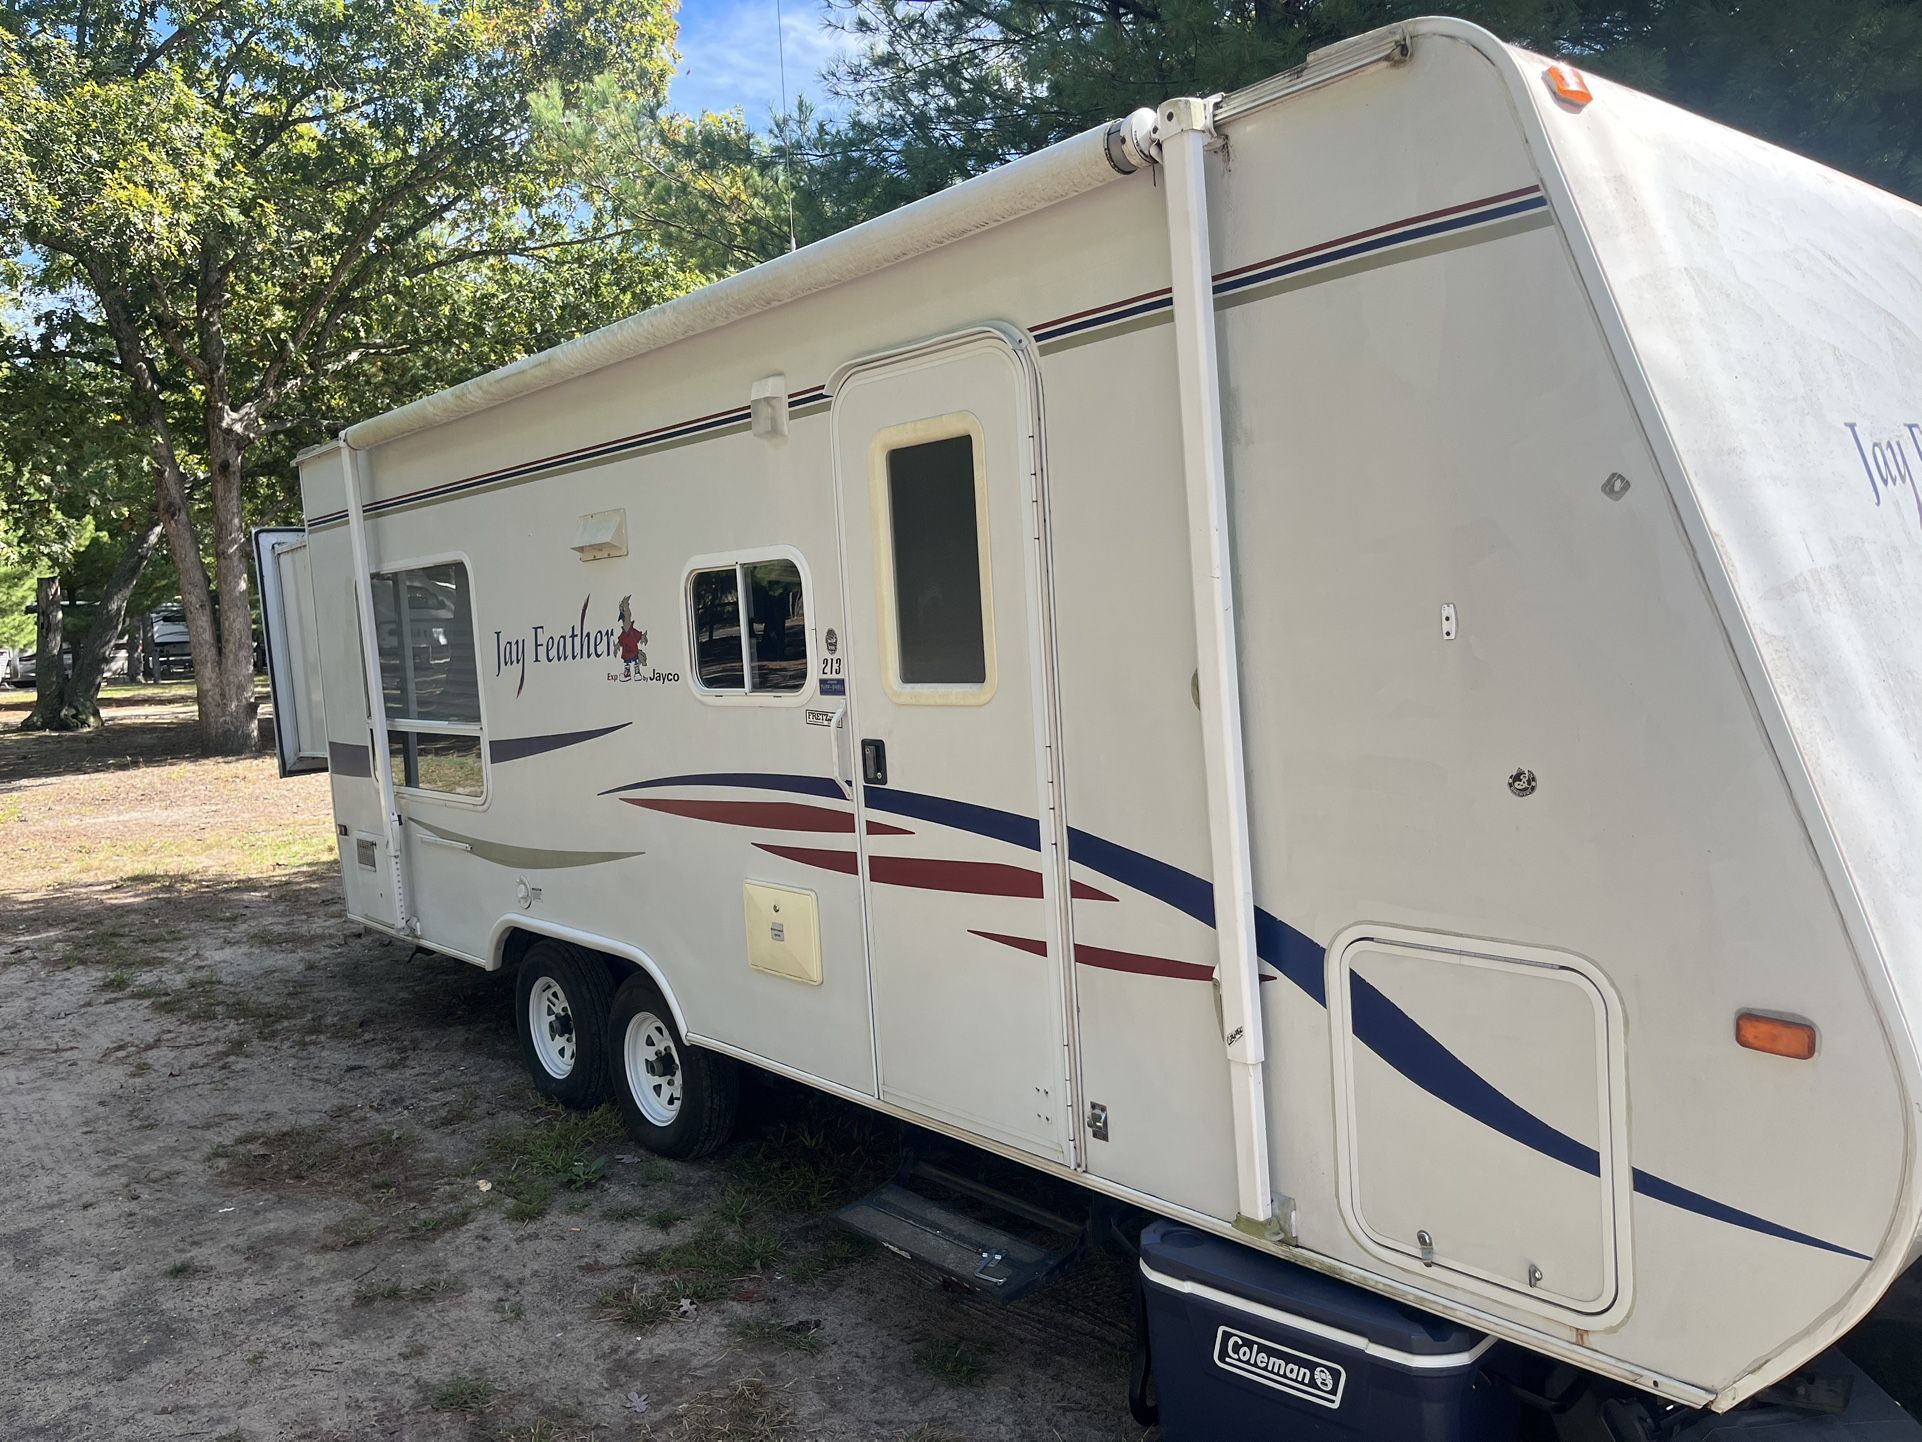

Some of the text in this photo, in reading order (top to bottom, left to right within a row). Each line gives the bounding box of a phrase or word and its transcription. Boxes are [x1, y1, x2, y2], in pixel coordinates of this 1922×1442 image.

[1843, 422, 1922, 530] Jay
[495, 593, 614, 699] Jay Feather
[607, 672, 618, 682] Exp
[649, 668, 680, 684] Jayco
[822, 658, 841, 674] 213
[808, 711, 829, 721] FRETZ
[1228, 1336, 1310, 1384] Coleman
